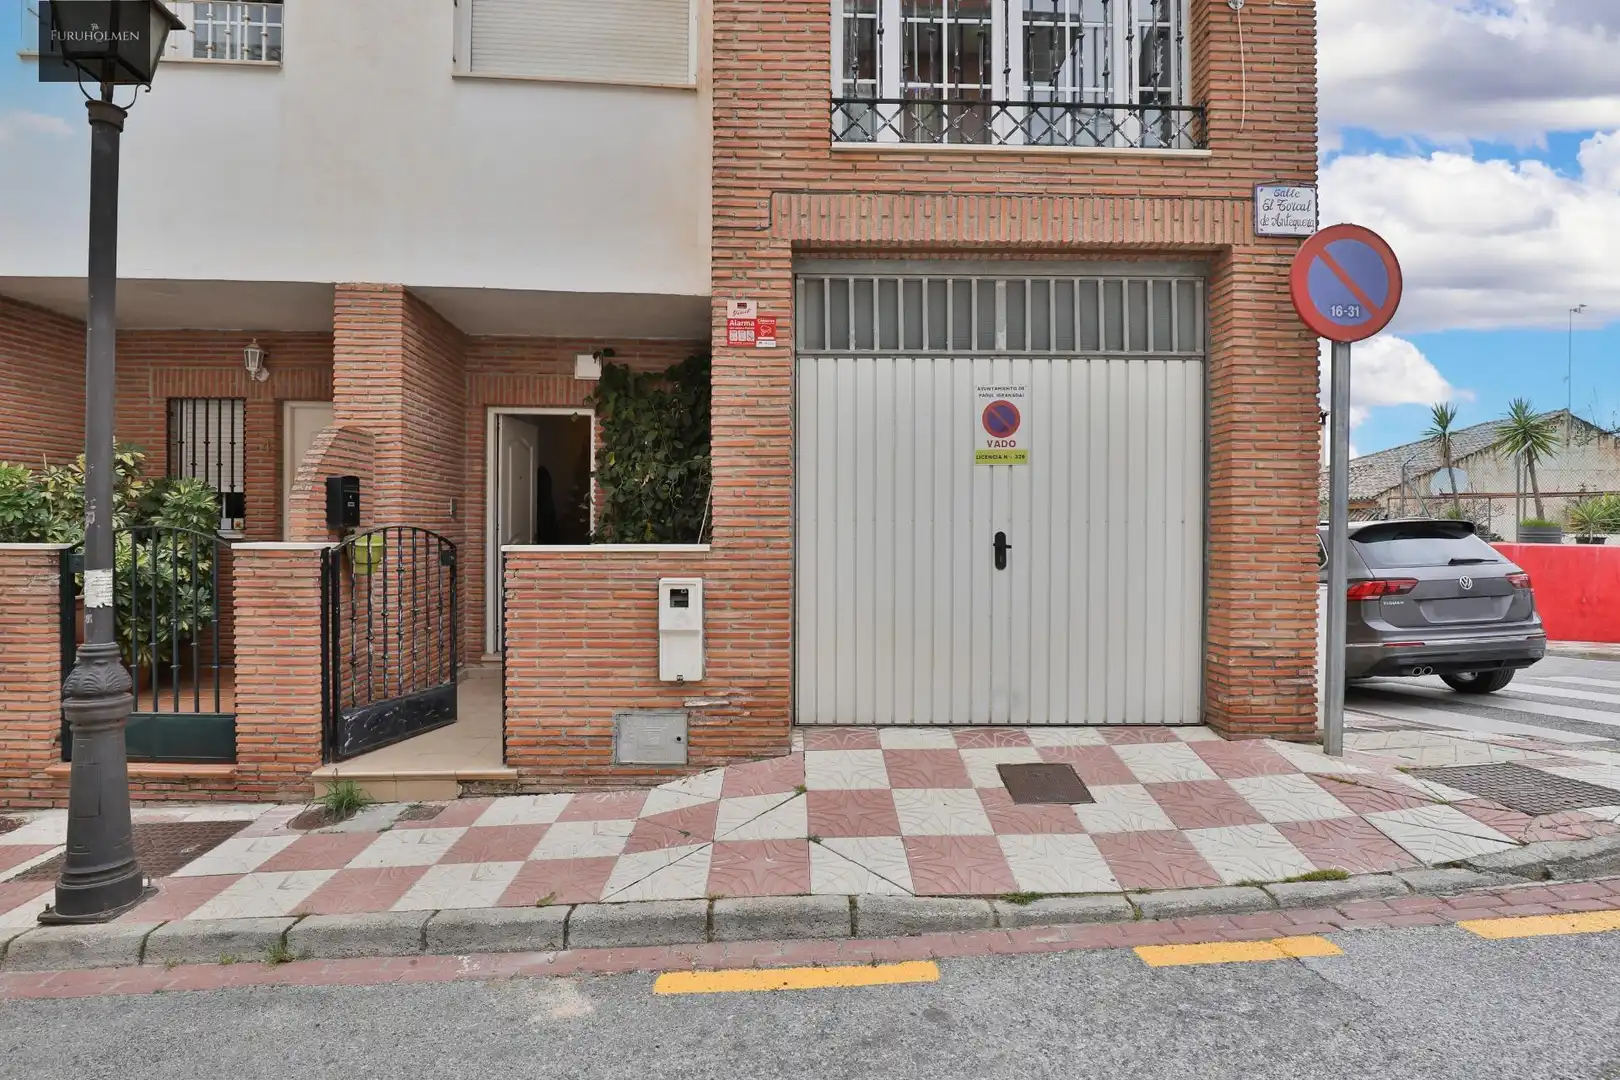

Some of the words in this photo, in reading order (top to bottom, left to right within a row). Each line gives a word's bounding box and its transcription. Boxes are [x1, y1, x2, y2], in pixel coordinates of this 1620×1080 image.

[1273, 188, 1301, 198] Calle
[1262, 198, 1274, 211] El
[1260, 214, 1269, 226] de
[1331, 305, 1360, 317] 16-31
[729, 319, 755, 327] Alarma
[986, 439, 1017, 448] VADO
